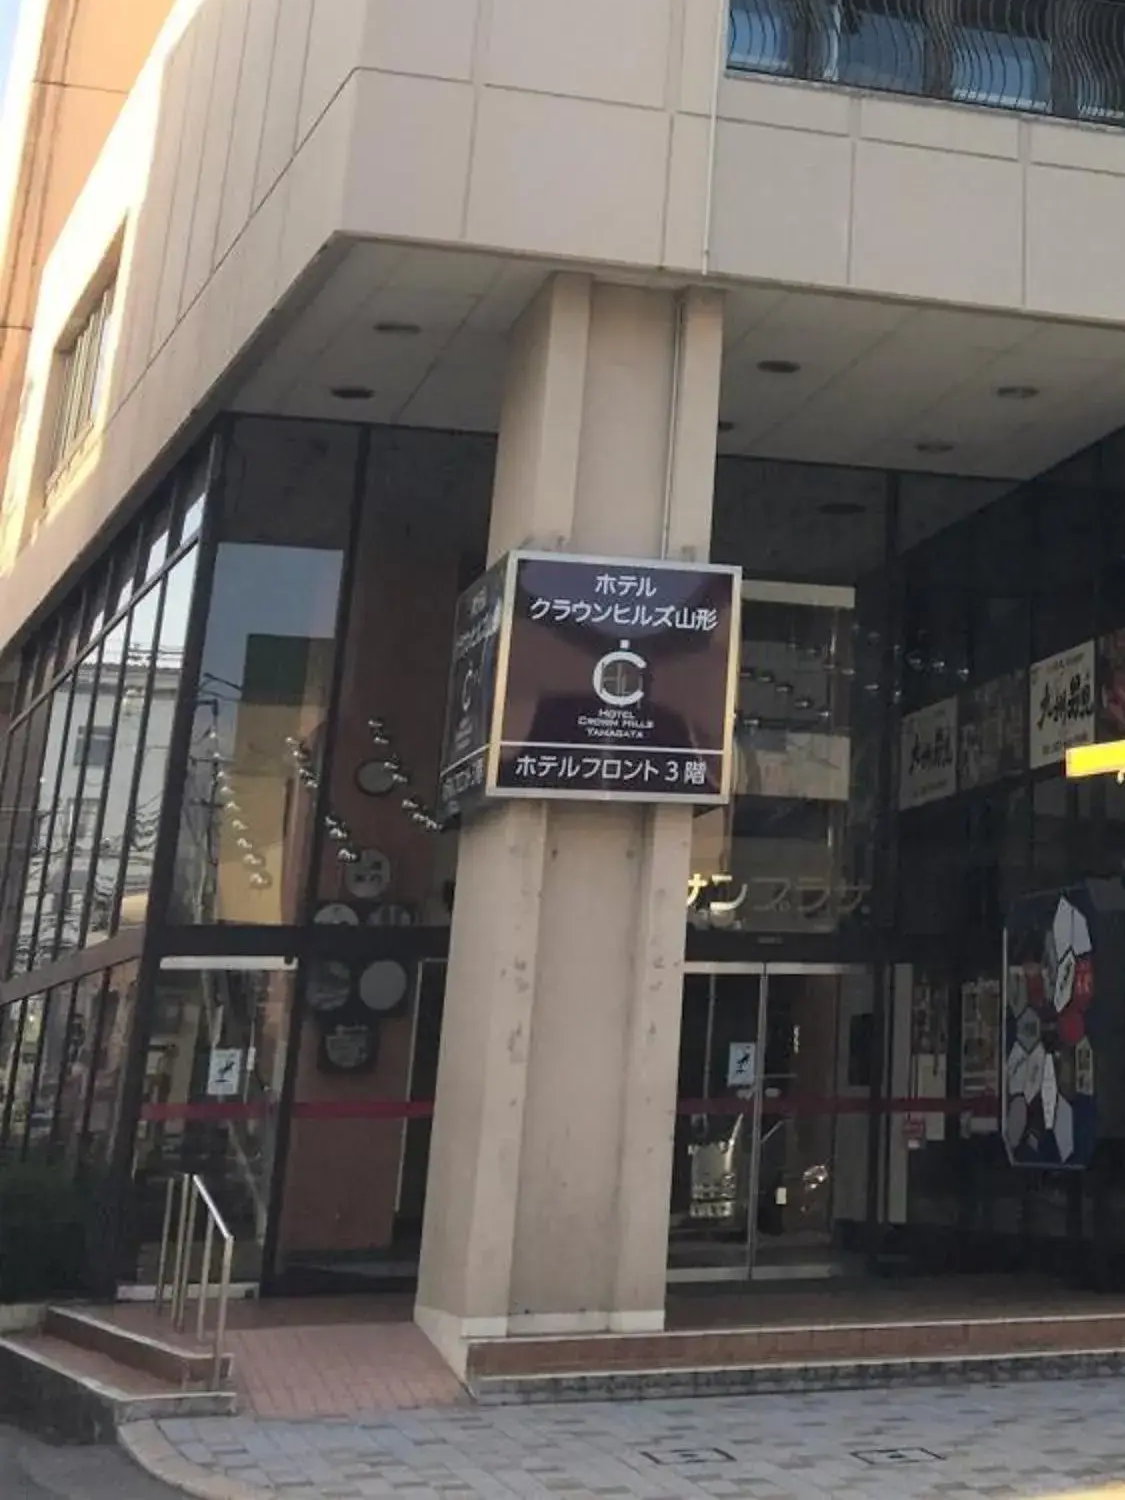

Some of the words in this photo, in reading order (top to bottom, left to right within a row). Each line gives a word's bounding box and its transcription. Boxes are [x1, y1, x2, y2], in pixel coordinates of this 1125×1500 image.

[595, 573, 657, 597] ホテル
[530, 597, 719, 631] クラウンヒルズ山形
[598, 707, 635, 720] HOTEL
[577, 715, 619, 727] CROWN
[622, 718, 654, 729] HILLS
[585, 726, 643, 739] YAMAGATA
